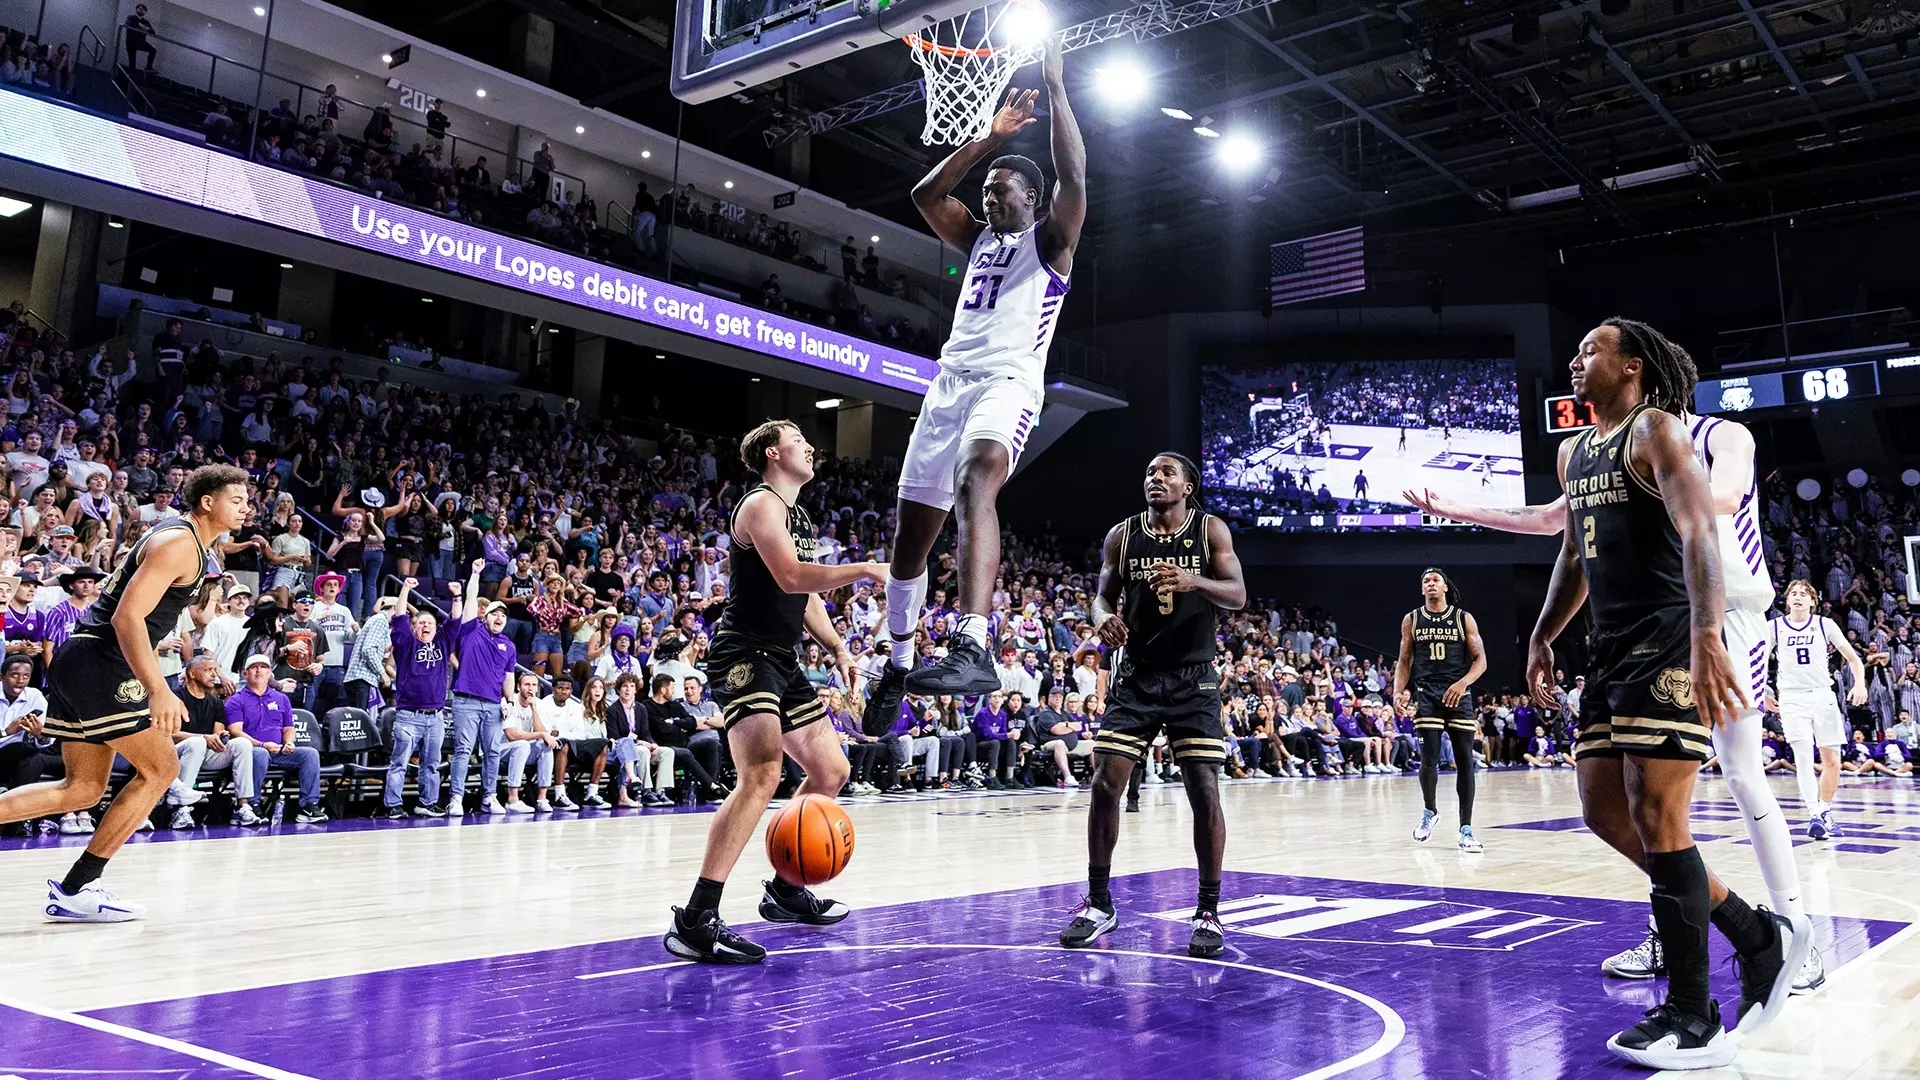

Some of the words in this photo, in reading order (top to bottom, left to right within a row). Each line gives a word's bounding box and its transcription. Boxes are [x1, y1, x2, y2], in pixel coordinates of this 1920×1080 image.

[777, 195, 791, 206] 202
[974, 246, 1018, 269] GU
[352, 204, 410, 245] Use
[419, 229, 487, 265] your
[495, 245, 576, 290] Lopes
[583, 272, 647, 310] debit
[653, 294, 710, 330] card,
[715, 312, 751, 338] get
[756, 320, 796, 350] free
[801, 331, 871, 373] laundry
[963, 274, 1004, 310] 31
[1802, 368, 1849, 402] 68
[1570, 496, 1584, 511] RT
[1586, 489, 1629, 508] WAYNE
[1257, 516, 1284, 527] PFW
[1337, 515, 1363, 527] GCU
[1583, 515, 1597, 559] 2
[1415, 627, 1458, 636] PURDUE
[1416, 634, 1432, 642] FORT
[1787, 635, 1815, 647] GCU
[1429, 642, 1446, 661] 10
[1796, 648, 1811, 665] 8
[293, 721, 308, 732] CU
[340, 719, 362, 731] GCU
[340, 730, 367, 738] GLOBAL
